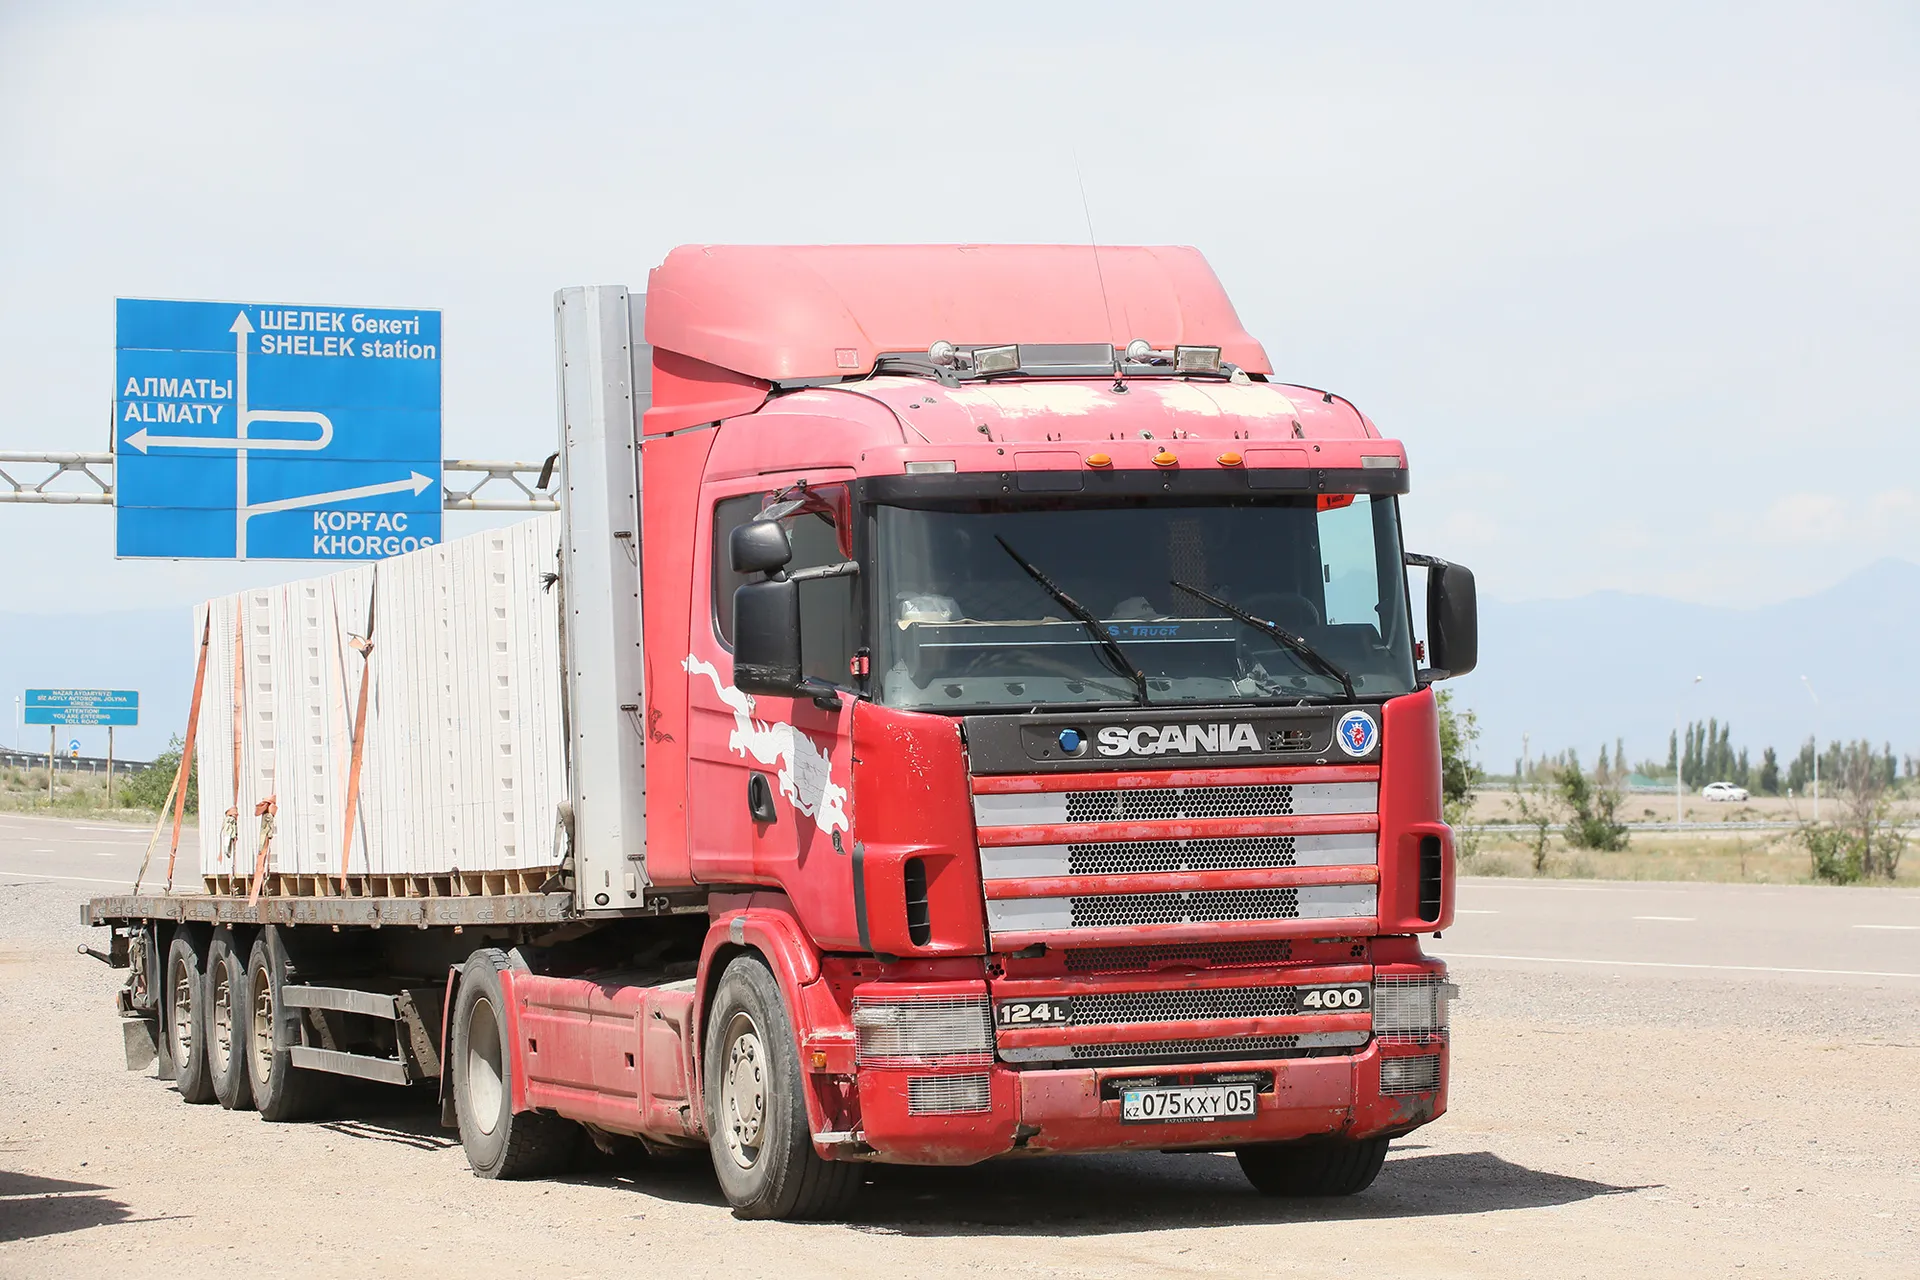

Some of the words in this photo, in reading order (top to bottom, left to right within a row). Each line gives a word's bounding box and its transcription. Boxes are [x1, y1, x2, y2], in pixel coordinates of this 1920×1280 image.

[260, 310, 345, 333] ШЕЛЕК
[351, 313, 419, 335] бекеті
[260, 334, 355, 357] SHELEK
[361, 338, 436, 360] station
[123, 377, 233, 400] АЛМАТЫ
[123, 403, 224, 424] ALMATY
[313, 511, 408, 534] ҚОРҒАС
[1096, 722, 1262, 757] SCANIA
[1303, 989, 1362, 1009] 400
[1125, 1107, 1140, 1118] KZ
[1226, 1089, 1252, 1112] 05
